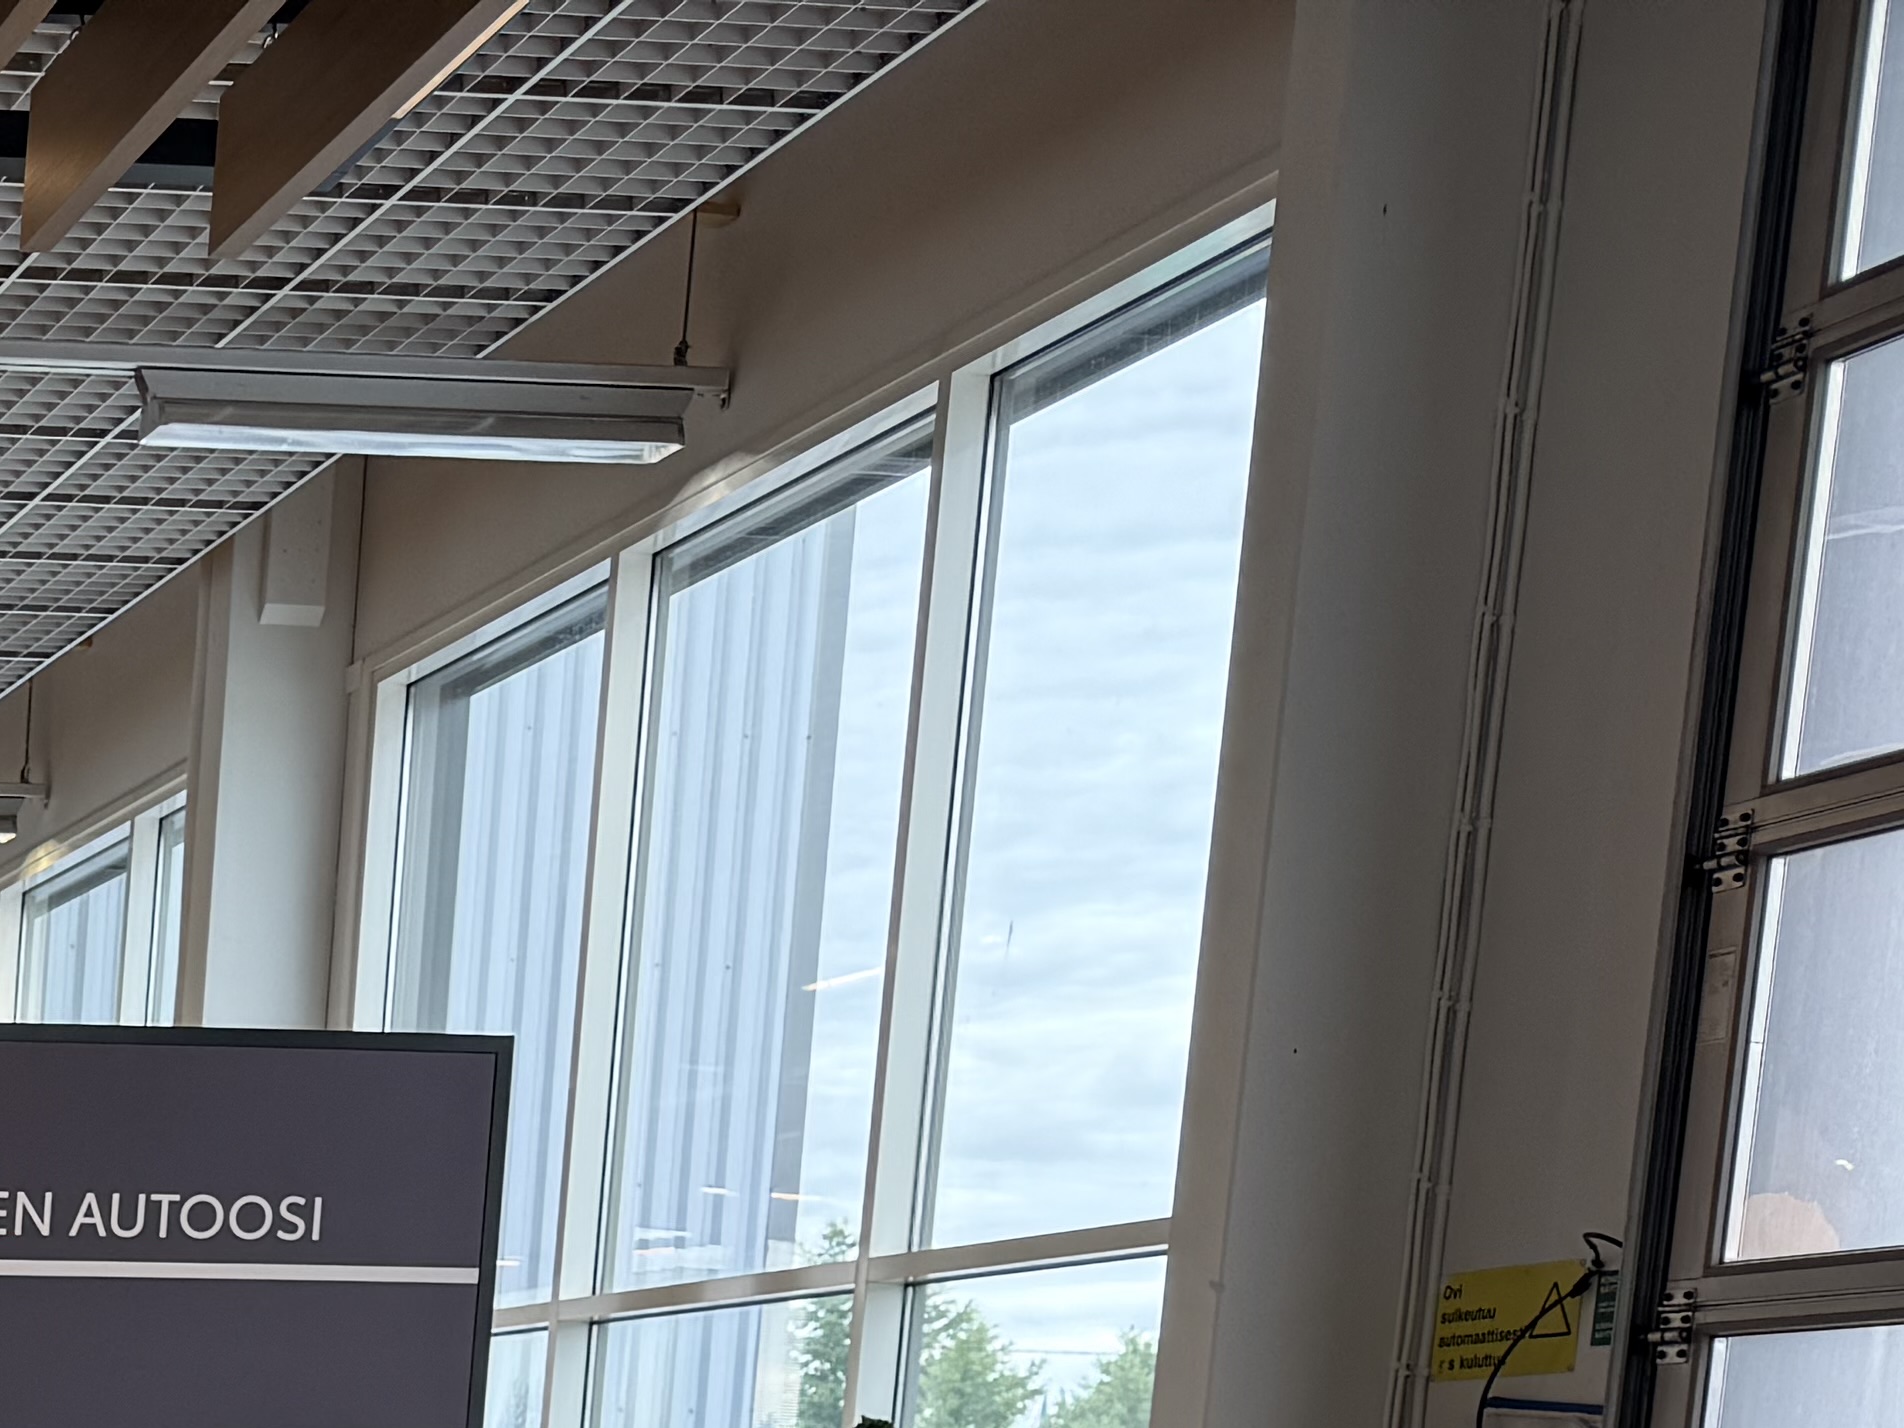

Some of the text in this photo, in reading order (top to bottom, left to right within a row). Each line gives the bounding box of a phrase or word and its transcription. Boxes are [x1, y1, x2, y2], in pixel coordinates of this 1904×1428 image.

[68, 1192, 324, 1241] AUTOOSI
[1443, 1284, 1463, 1300] Ovi
[1440, 1307, 1496, 1324] sulkeutuu
